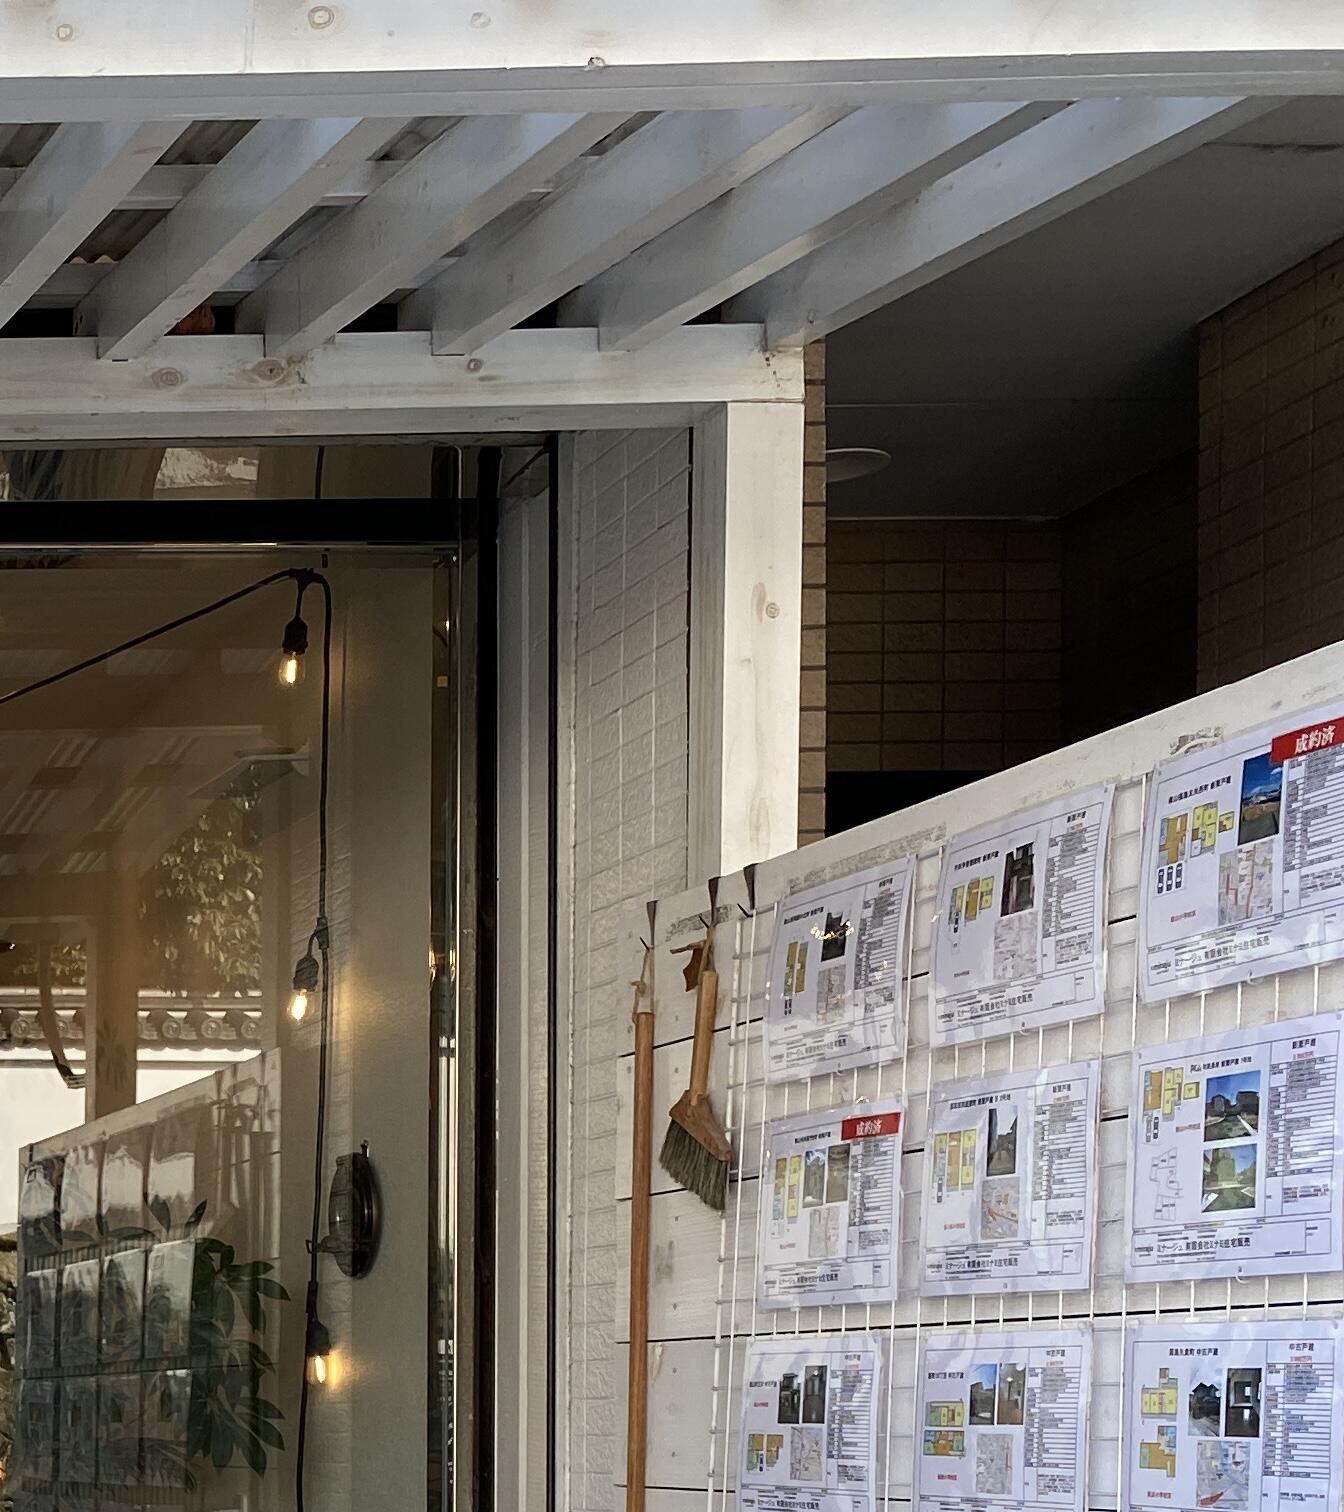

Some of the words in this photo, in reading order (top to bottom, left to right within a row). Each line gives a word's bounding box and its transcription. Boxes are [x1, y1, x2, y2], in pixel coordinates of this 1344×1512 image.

[1295, 725, 1336, 754] 成約済
[856, 1119, 883, 1136] 成約済
